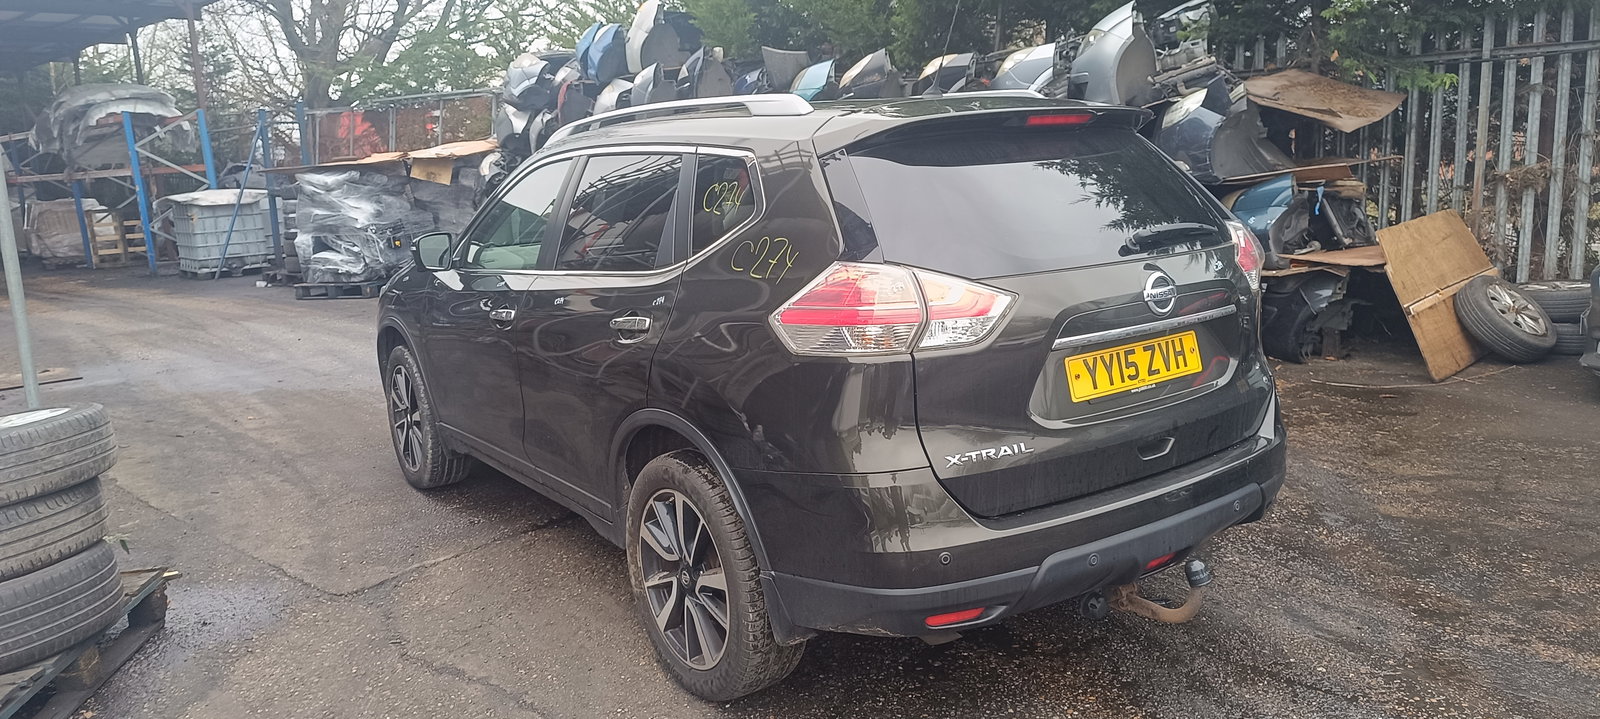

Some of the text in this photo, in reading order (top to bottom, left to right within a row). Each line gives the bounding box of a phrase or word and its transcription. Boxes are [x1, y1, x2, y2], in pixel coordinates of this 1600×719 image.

[703, 181, 745, 215] C274
[731, 236, 799, 285] C274
[1149, 287, 1177, 299] NISSAN
[1083, 337, 1188, 390] YY15 ZVH
[944, 442, 1035, 468] X-TRAIL
